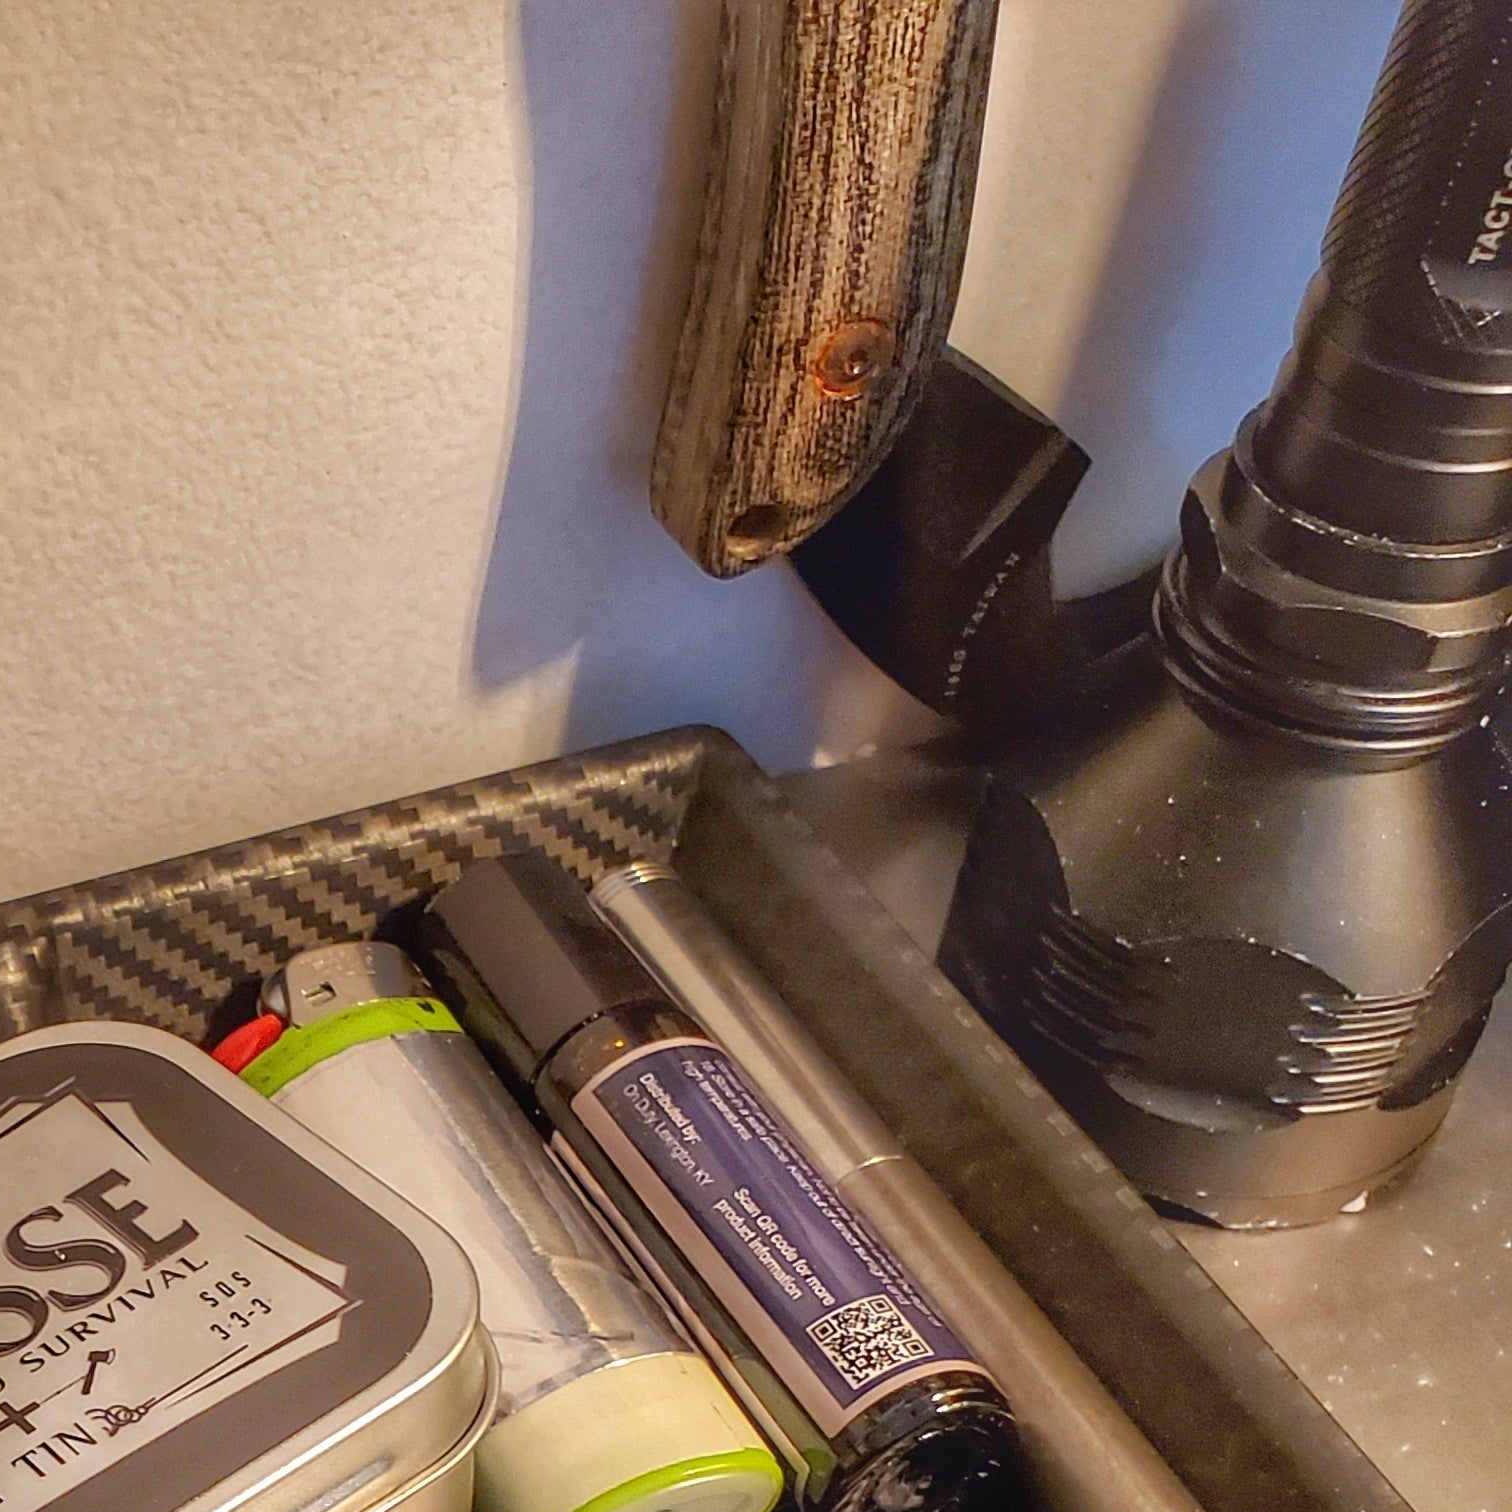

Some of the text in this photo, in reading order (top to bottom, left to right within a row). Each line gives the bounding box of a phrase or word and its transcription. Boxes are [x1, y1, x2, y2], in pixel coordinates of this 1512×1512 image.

[622, 1083, 640, 1103] On
[692, 1168, 715, 1186] KY
[639, 1072, 702, 1145] Distributed by:
[712, 1199, 757, 1242] product
[748, 1236, 803, 1300] information
[733, 1187, 836, 1306] Scan QR code for more
[19, 1255, 209, 1373] SURVIVAL
[11, 1422, 98, 1478] TIN
